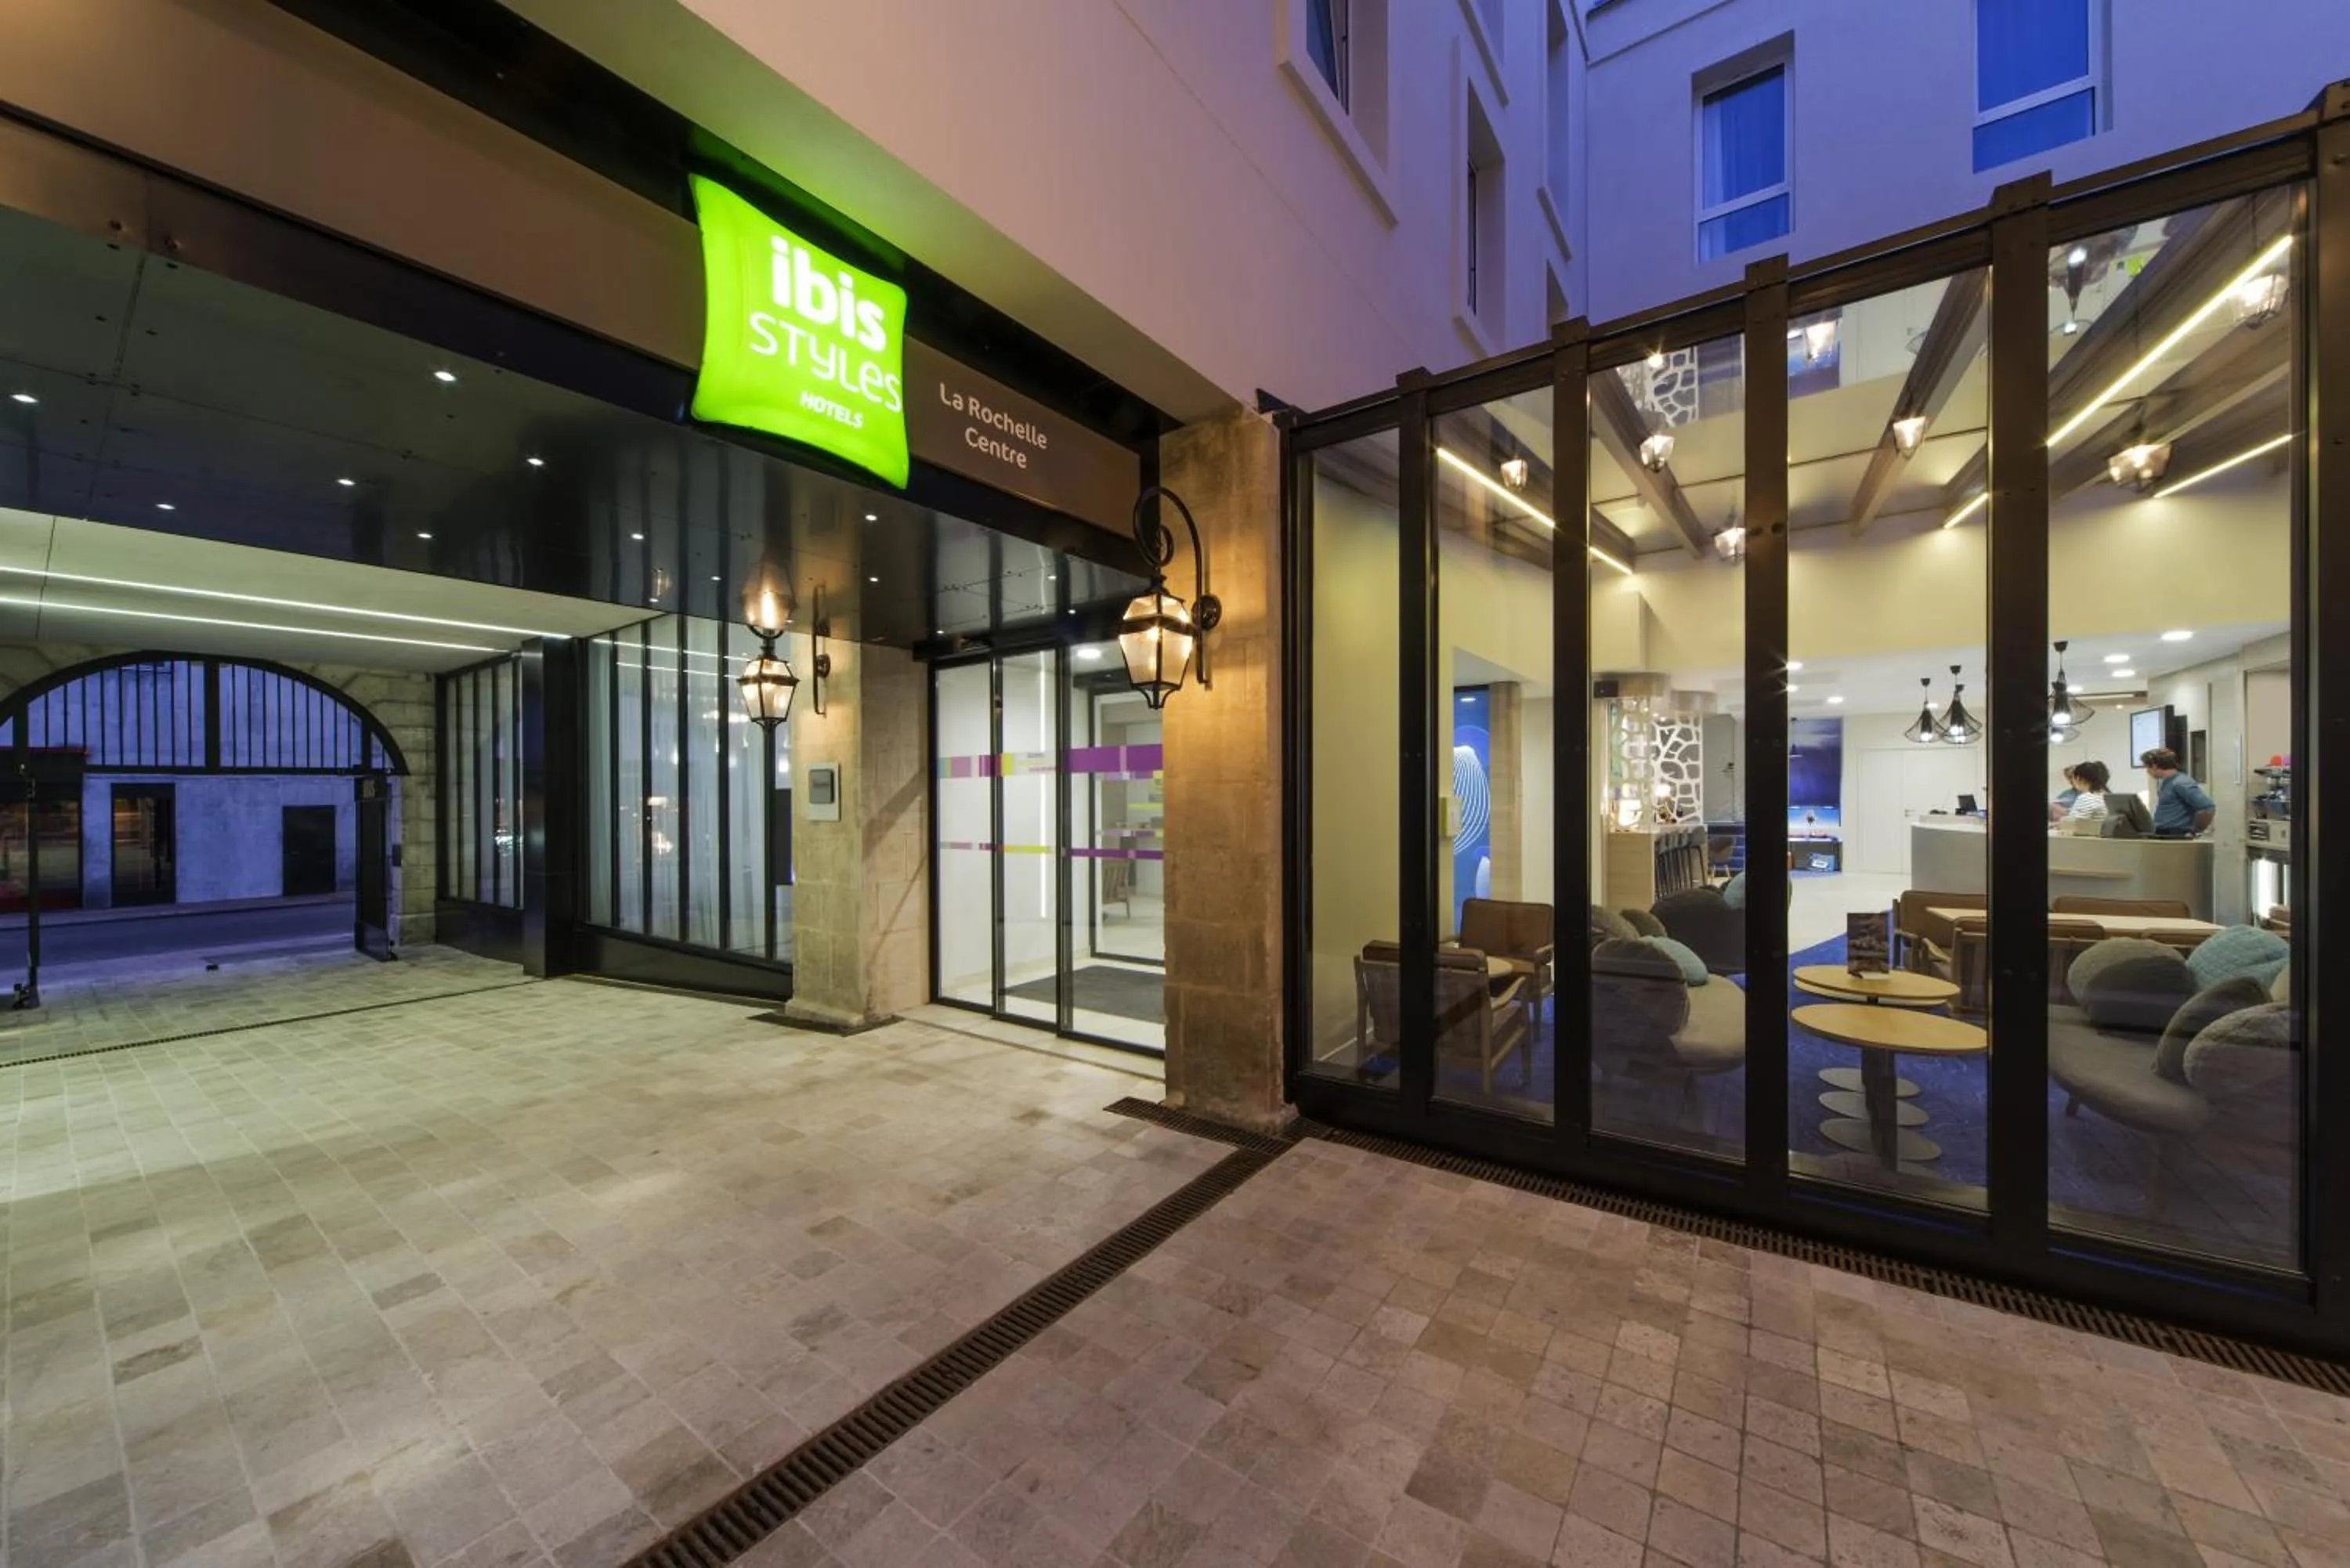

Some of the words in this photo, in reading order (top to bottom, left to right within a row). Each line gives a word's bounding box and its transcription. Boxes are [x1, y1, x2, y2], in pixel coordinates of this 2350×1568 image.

[771, 236, 886, 352] ibis
[801, 390, 863, 428] HOTELS
[940, 381, 964, 411] La
[968, 396, 1048, 450] Rochelle
[965, 426, 1027, 469] Centre
